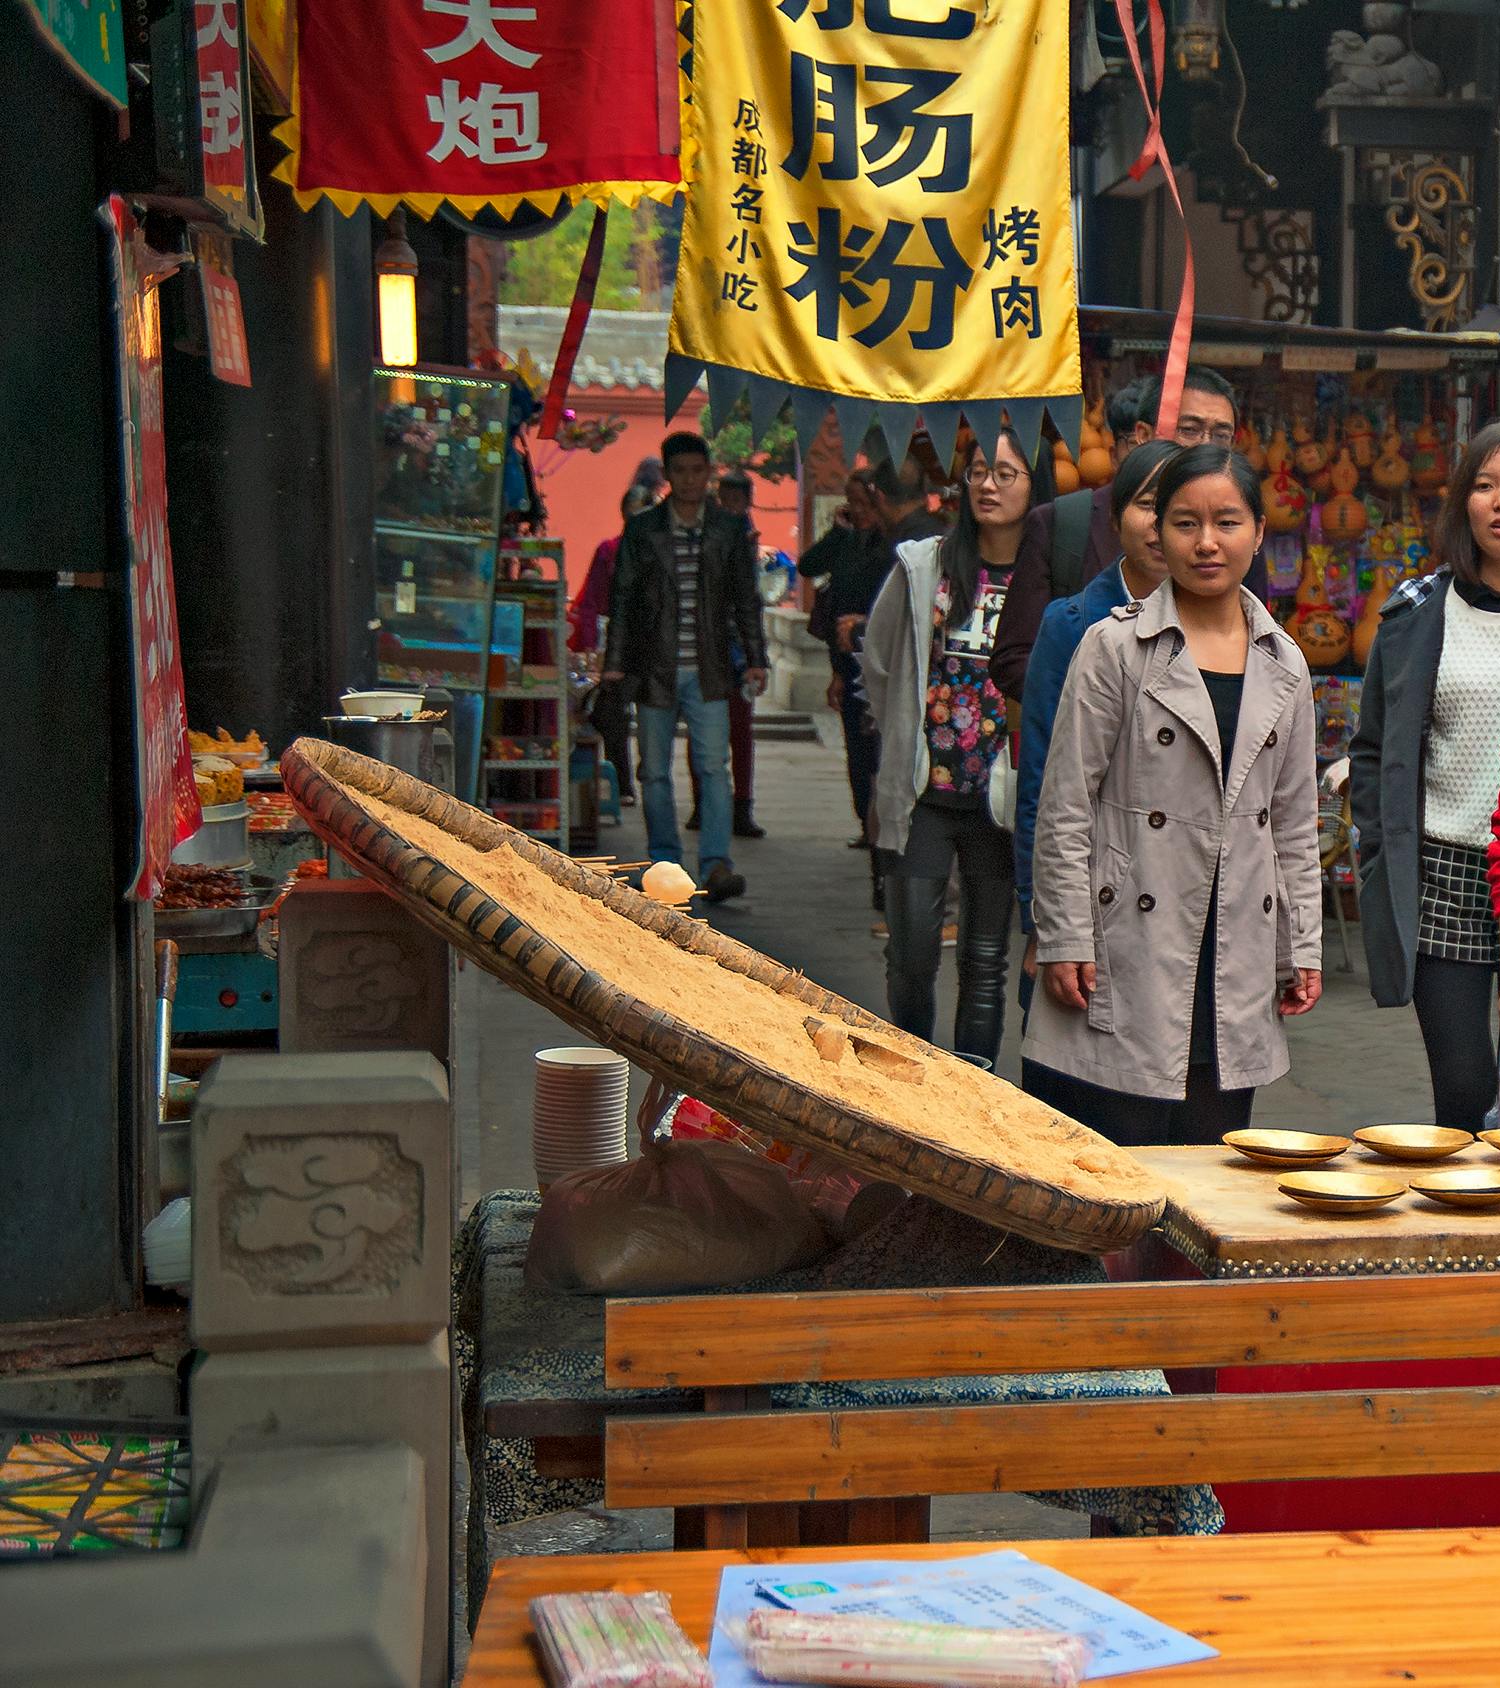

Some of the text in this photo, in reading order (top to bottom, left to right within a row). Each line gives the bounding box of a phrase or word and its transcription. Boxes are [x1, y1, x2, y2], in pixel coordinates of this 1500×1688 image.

[720, 97, 768, 313] 成都名小吃
[981, 205, 1043, 340] 烤肉
